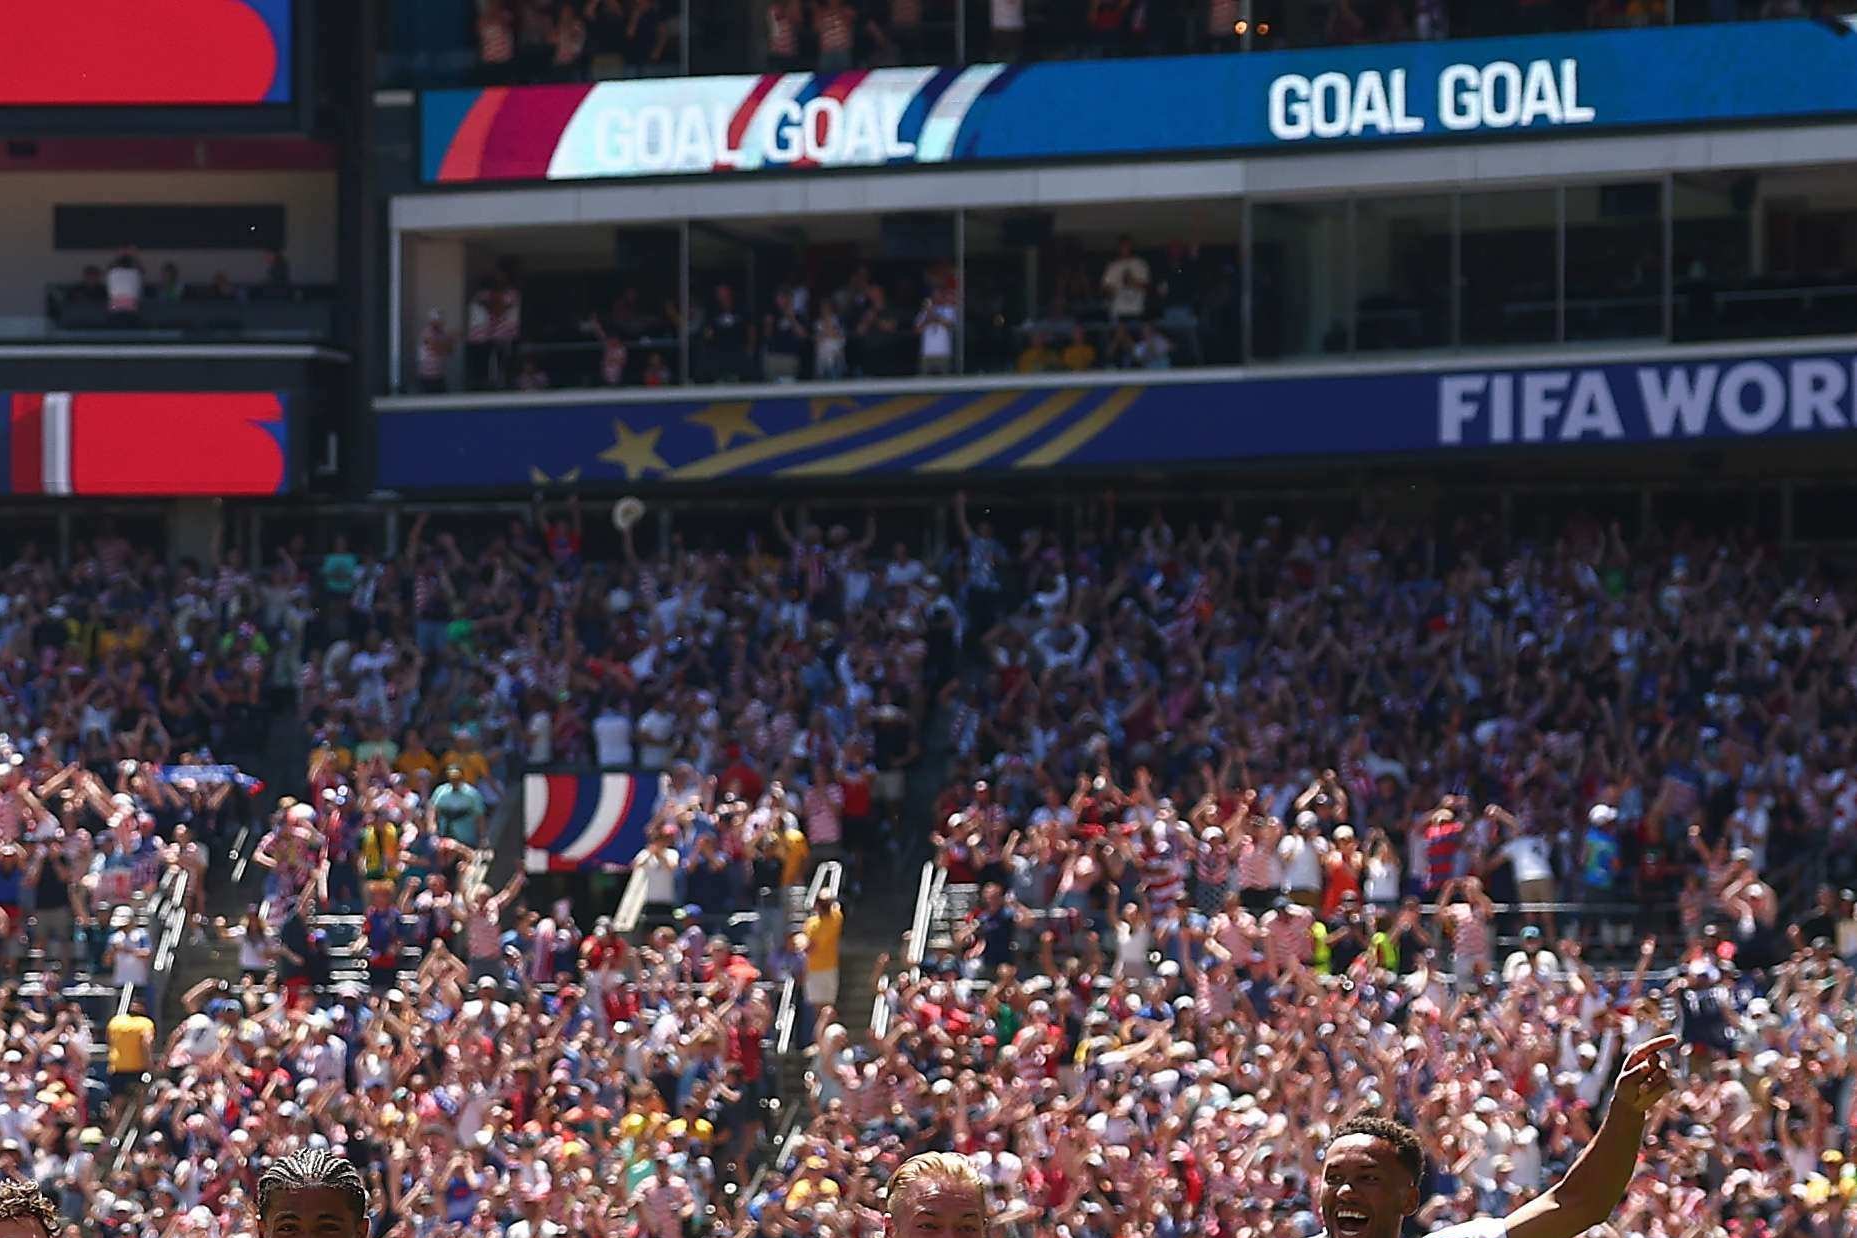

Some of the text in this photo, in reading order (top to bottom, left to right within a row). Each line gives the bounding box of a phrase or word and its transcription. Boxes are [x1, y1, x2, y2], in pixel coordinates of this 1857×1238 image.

[594, 90, 916, 167] GOAL GOAL
[1268, 58, 1596, 140] GOAL GOAL
[1438, 358, 1857, 445] FIFA WOR
